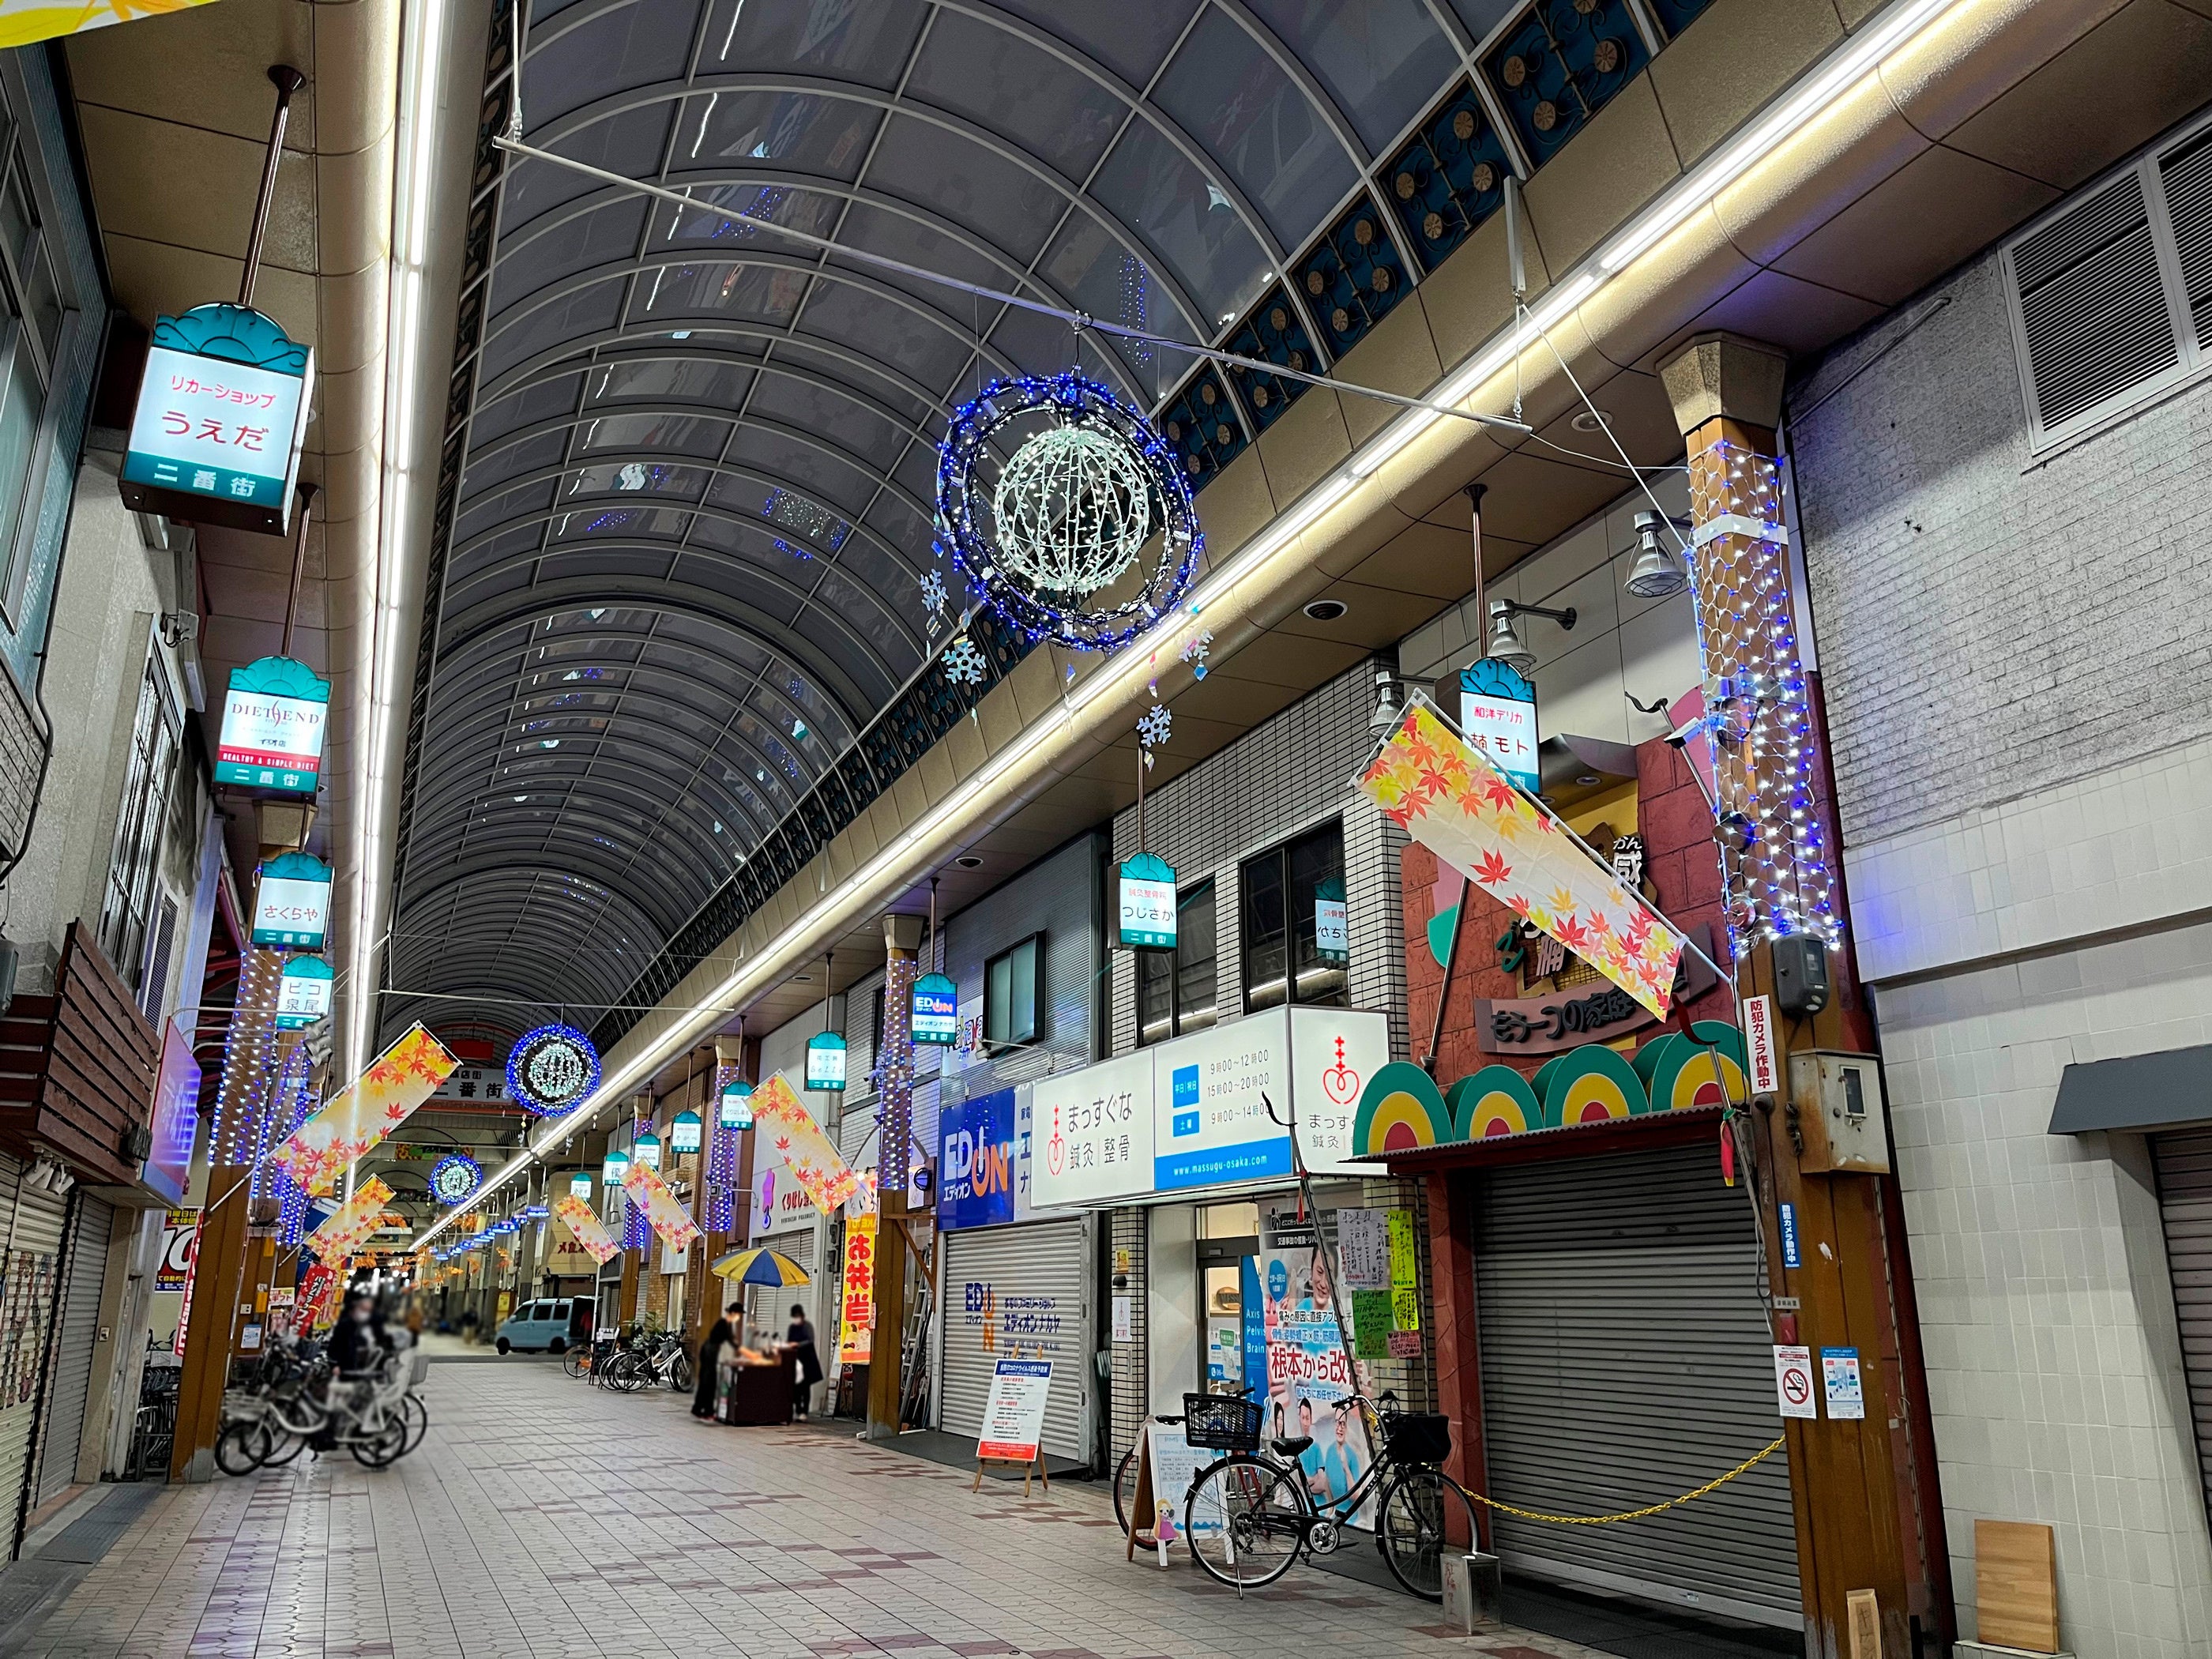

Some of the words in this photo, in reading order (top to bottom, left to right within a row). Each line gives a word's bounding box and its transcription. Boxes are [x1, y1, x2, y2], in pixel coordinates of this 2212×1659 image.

[171, 374, 276, 409] リカーショップ
[161, 409, 269, 452] うえだ
[153, 463, 256, 498] 二番街
[1473, 705, 1523, 724] 和洋デリカ
[223, 752, 254, 763] HEALTHY
[266, 758, 292, 768] SIMPLE
[234, 769, 299, 787] 二番街
[264, 905, 318, 922] さくらや
[1122, 906, 1175, 922] つじさか
[288, 981, 321, 995] ピコ
[284, 998, 320, 1013] 泉尾
[1750, 999, 1771, 1089] 防犯カメラ作動中
[433, 1082, 503, 1099] 二番街
[1068, 1090, 1132, 1133] まっすぐな
[1179, 1119, 1193, 1130] 土曜
[1103, 1134, 1130, 1163] 整骨
[943, 1125, 1009, 1198] EDION
[1173, 1155, 1268, 1176] www.massugu-osaka.com
[943, 1182, 971, 1202] エディオン
[1247, 1308, 1260, 1319] Axis
[1278, 1311, 1352, 1322] 痛みの原因に直接アプロチ
[1003, 1313, 1060, 1334] エディオンナカヤ
[1247, 1342, 1264, 1353] Brain
